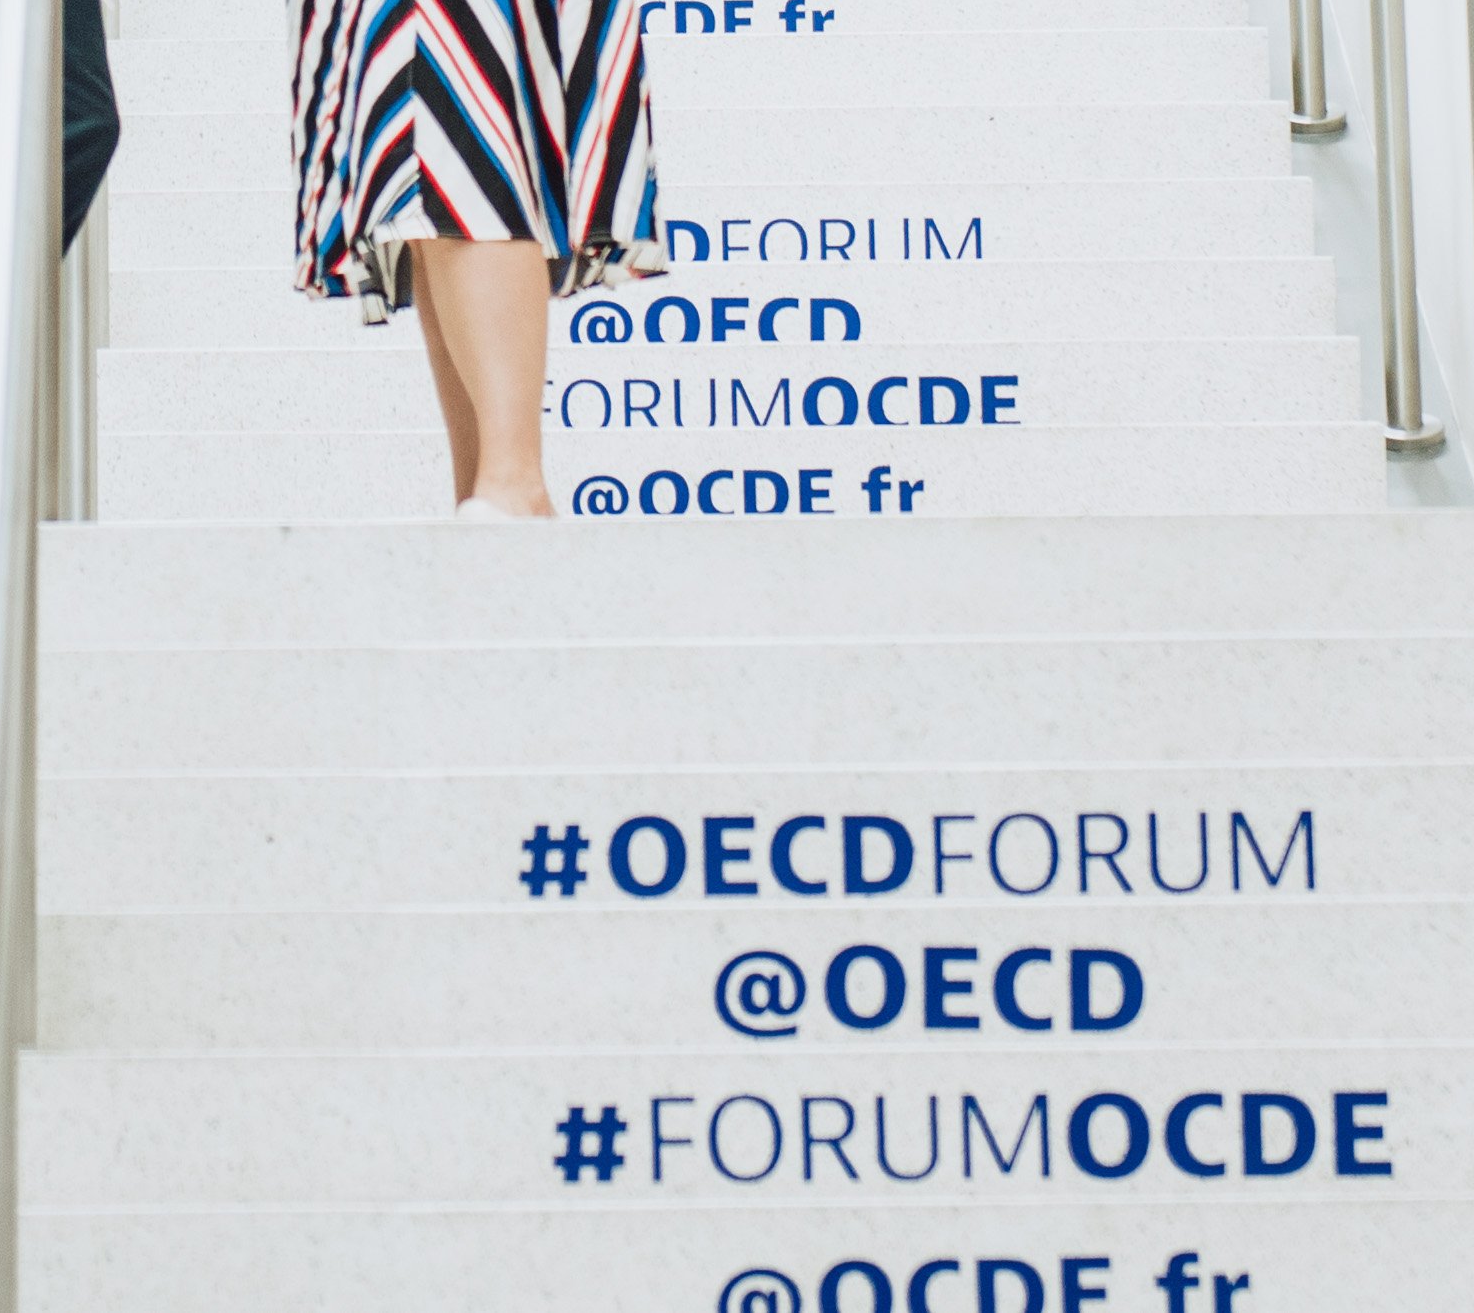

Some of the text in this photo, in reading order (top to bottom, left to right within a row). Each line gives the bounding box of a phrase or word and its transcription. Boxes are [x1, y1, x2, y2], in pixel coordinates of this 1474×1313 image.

[640, 0, 754, 35] CDE
[665, 217, 984, 262] DFORUM
[569, 296, 862, 344] @OECD
[540, 375, 1022, 428] ORUMOCDE
[519, 810, 1316, 899] #OECDFORUM
[714, 944, 1145, 1039] @OECD
[553, 1091, 1394, 1184] #FORUMOCDE
